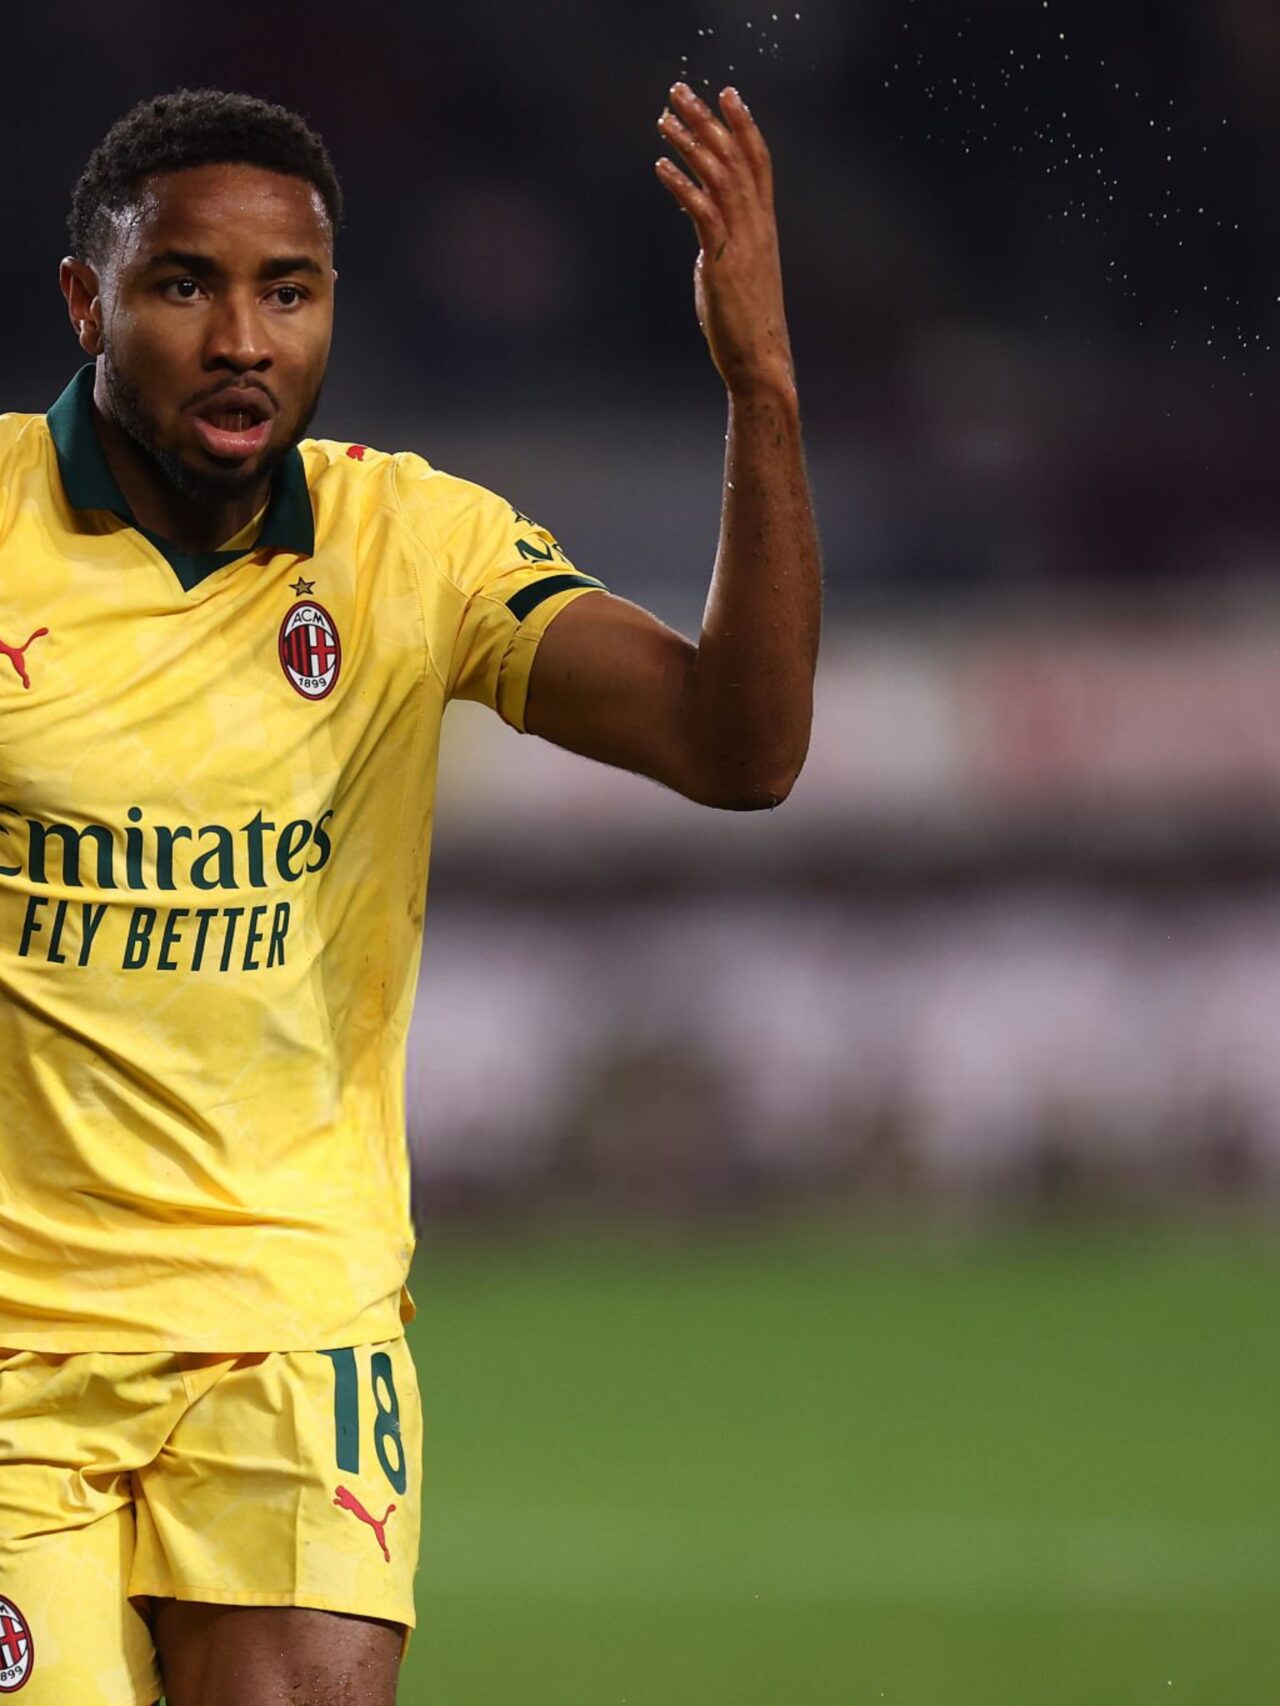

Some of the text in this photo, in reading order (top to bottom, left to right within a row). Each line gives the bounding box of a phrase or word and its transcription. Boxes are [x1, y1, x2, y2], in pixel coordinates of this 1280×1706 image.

[291, 608, 325, 627] ACM
[298, 677, 327, 688] 1899
[18, 895, 291, 972] FLY BETTER
[315, 1346, 407, 1495] 18
